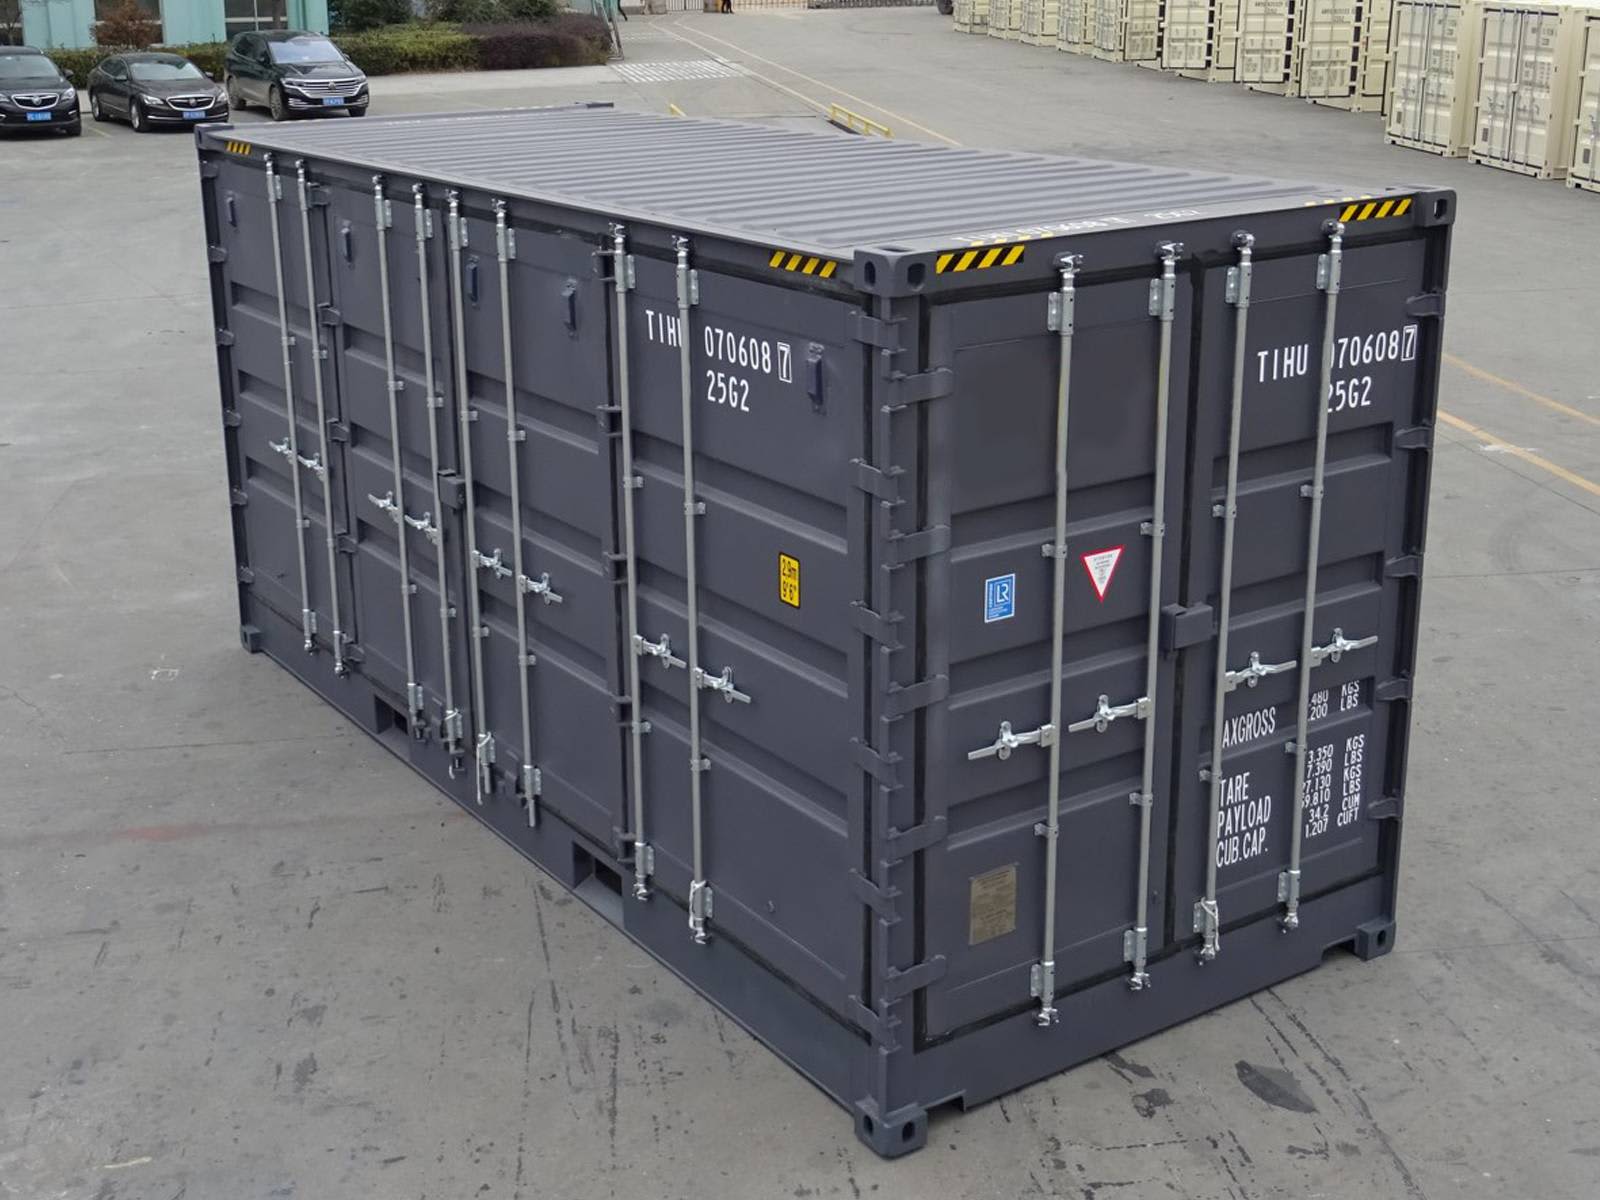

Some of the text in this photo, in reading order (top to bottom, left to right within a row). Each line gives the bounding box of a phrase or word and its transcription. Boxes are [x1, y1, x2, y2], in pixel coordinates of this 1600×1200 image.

[646, 310, 792, 382] TIH 070608 7
[1257, 344, 1309, 383] TIHU
[1402, 326, 1416, 360] 7
[706, 370, 750, 412] 25G2
[1340, 692, 1359, 711] LBS
[1308, 733, 1365, 764] 3.350 KGS
[1344, 749, 1362, 767] LBS
[1220, 771, 1250, 807] TARE
[1343, 763, 1361, 782] KGS
[1343, 778, 1361, 796] LBS
[1217, 795, 1272, 840] PAYLOAD
[1337, 806, 1360, 827] CUFT
[1216, 826, 1269, 868] CUB.CAP.
